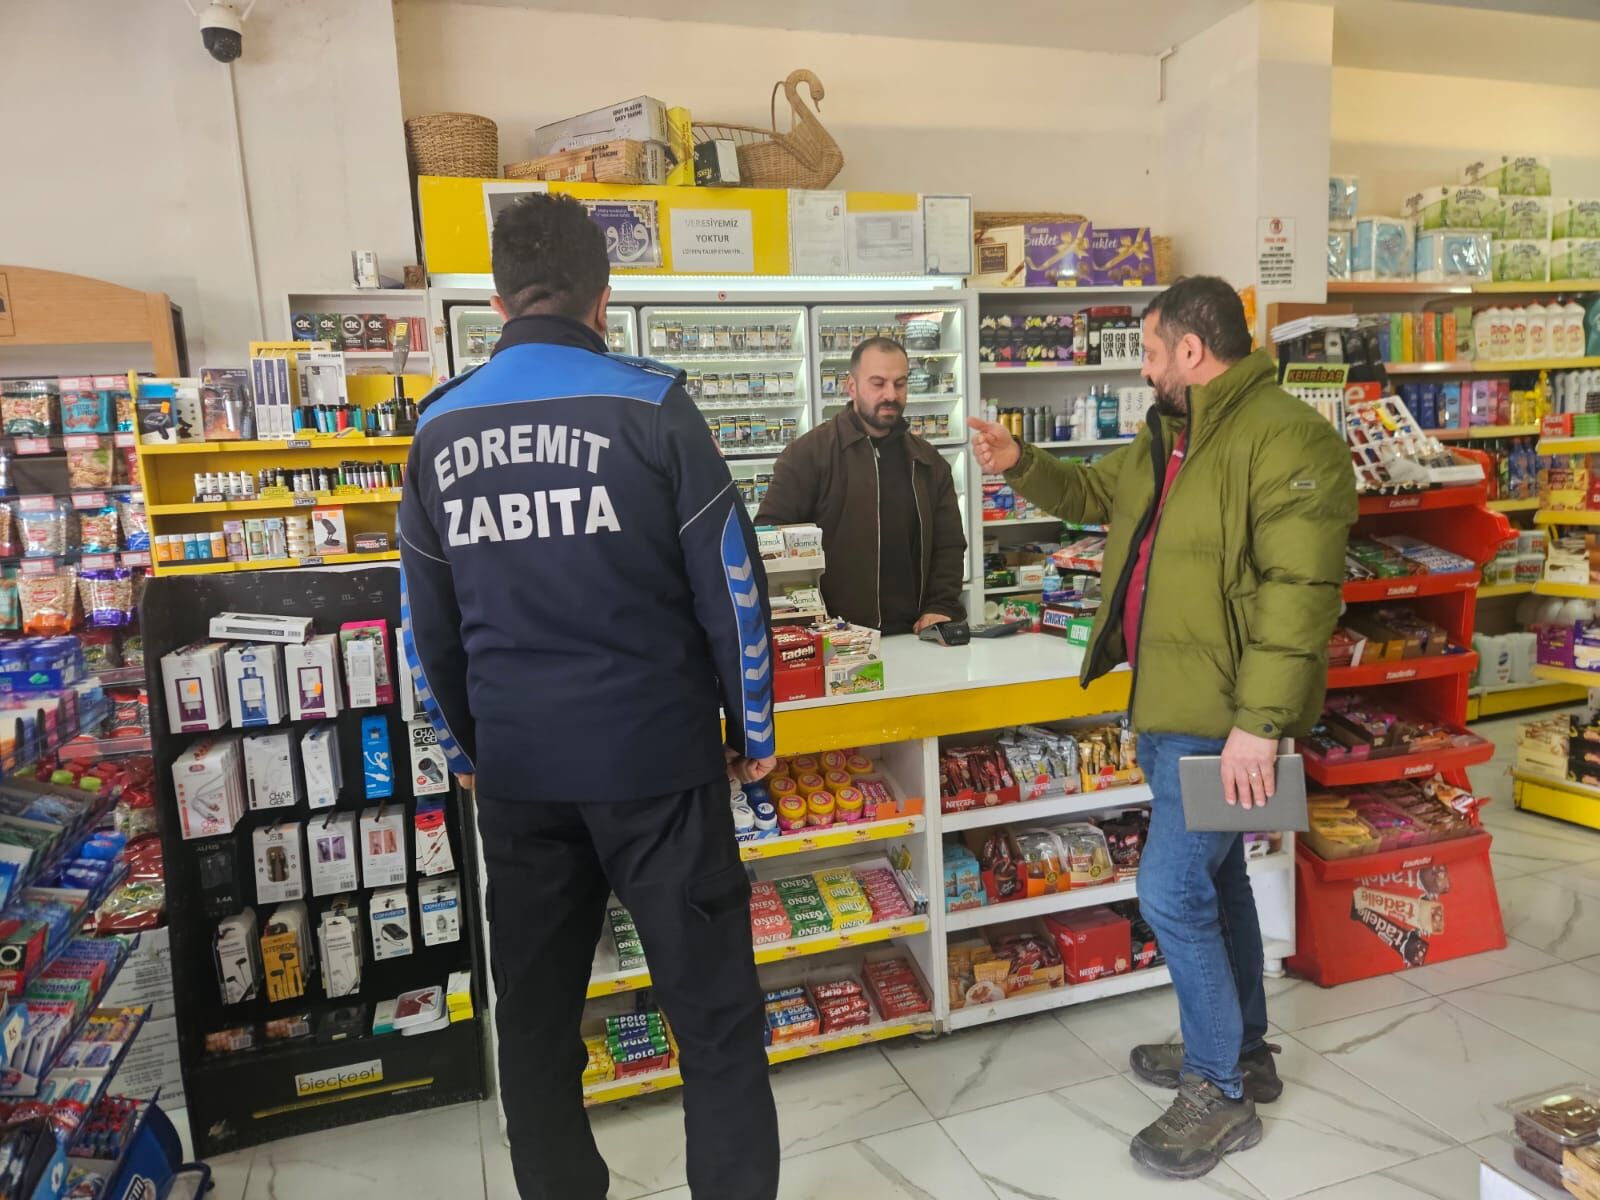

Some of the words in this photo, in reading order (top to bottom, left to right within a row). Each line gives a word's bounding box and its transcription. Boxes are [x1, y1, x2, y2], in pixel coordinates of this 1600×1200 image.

[696, 234, 729, 243] YOKTUR
[1103, 333, 1114, 342] GO
[1115, 333, 1126, 342] GO
[1128, 332, 1139, 341] GO
[1103, 350, 1114, 358] YA
[1115, 350, 1126, 358] YA
[1128, 349, 1139, 357] YA
[1288, 366, 1344, 384] KEHRİBAR
[443, 485, 621, 547] ZABITA
[414, 729, 435, 738] CHA
[788, 896, 815, 905] ONEO
[1361, 890, 1415, 919] tadelle
[794, 911, 823, 921] ONEO
[798, 925, 827, 936] ONEO
[620, 1014, 647, 1023] POLO
[628, 1048, 655, 1062] POLO
